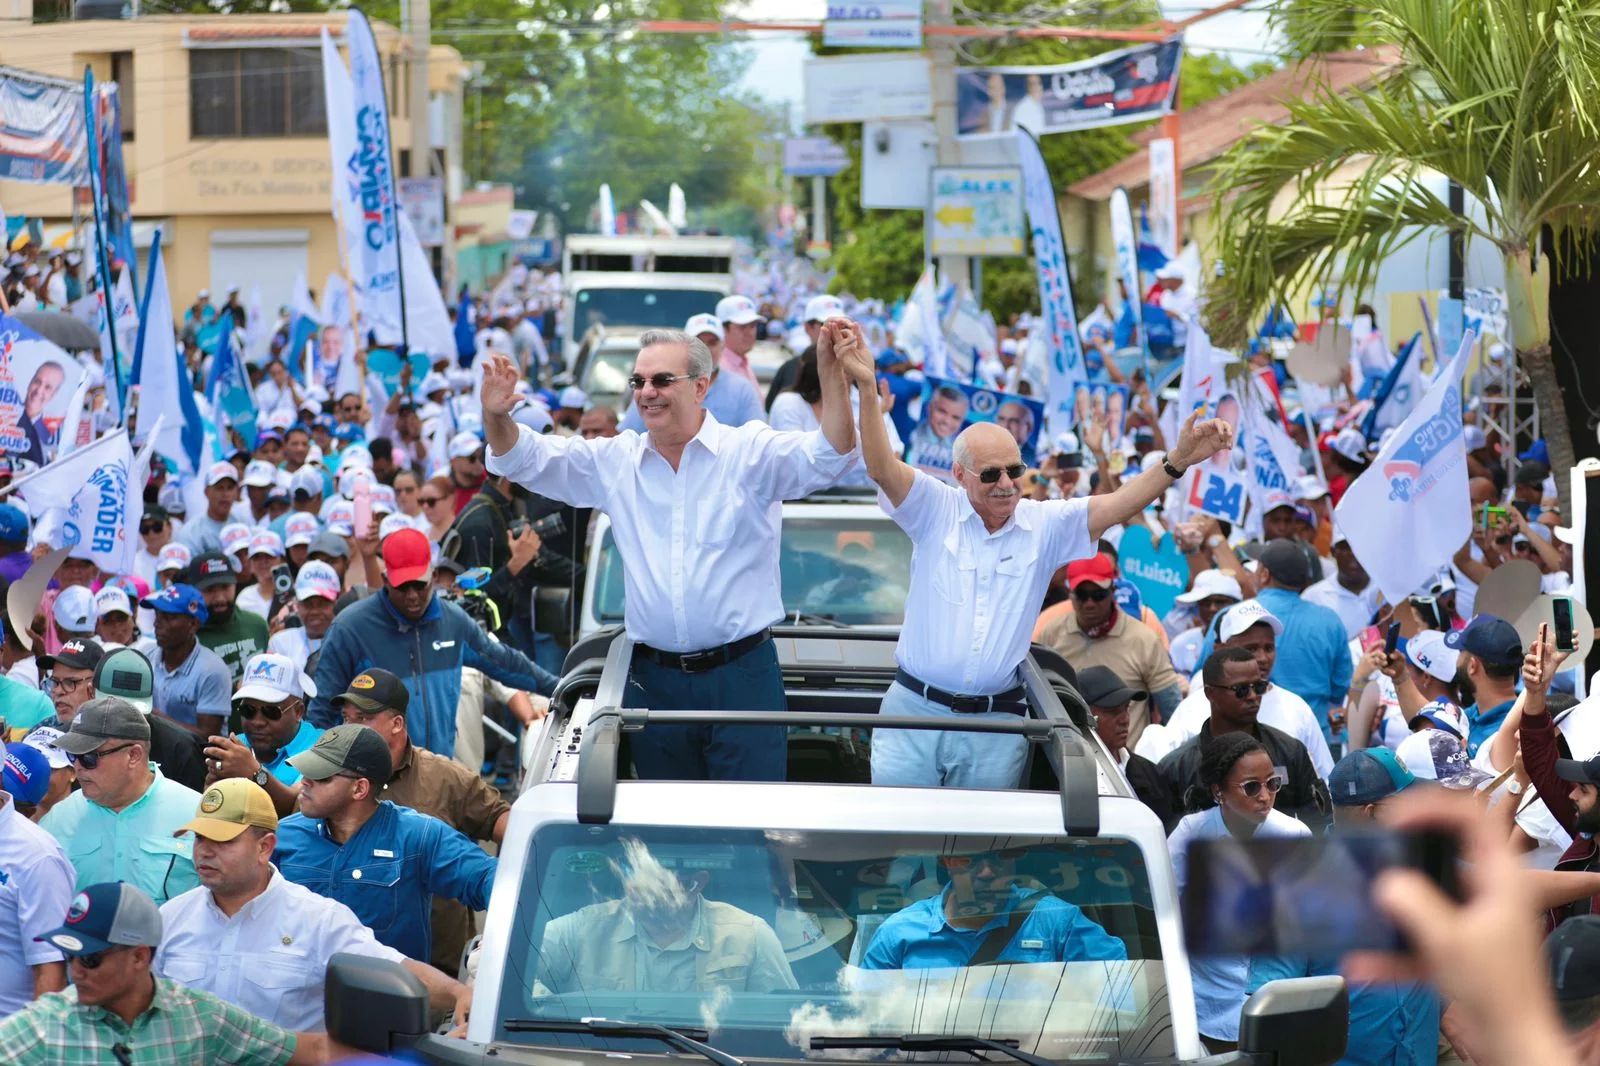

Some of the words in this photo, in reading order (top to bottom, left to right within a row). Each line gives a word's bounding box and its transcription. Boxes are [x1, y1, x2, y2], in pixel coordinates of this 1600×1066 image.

[356, 104, 383, 251] CAMBIO
[1189, 468, 1243, 521] L24
[1124, 557, 1183, 589] #Luis24
[1416, 650, 1432, 669] L24
